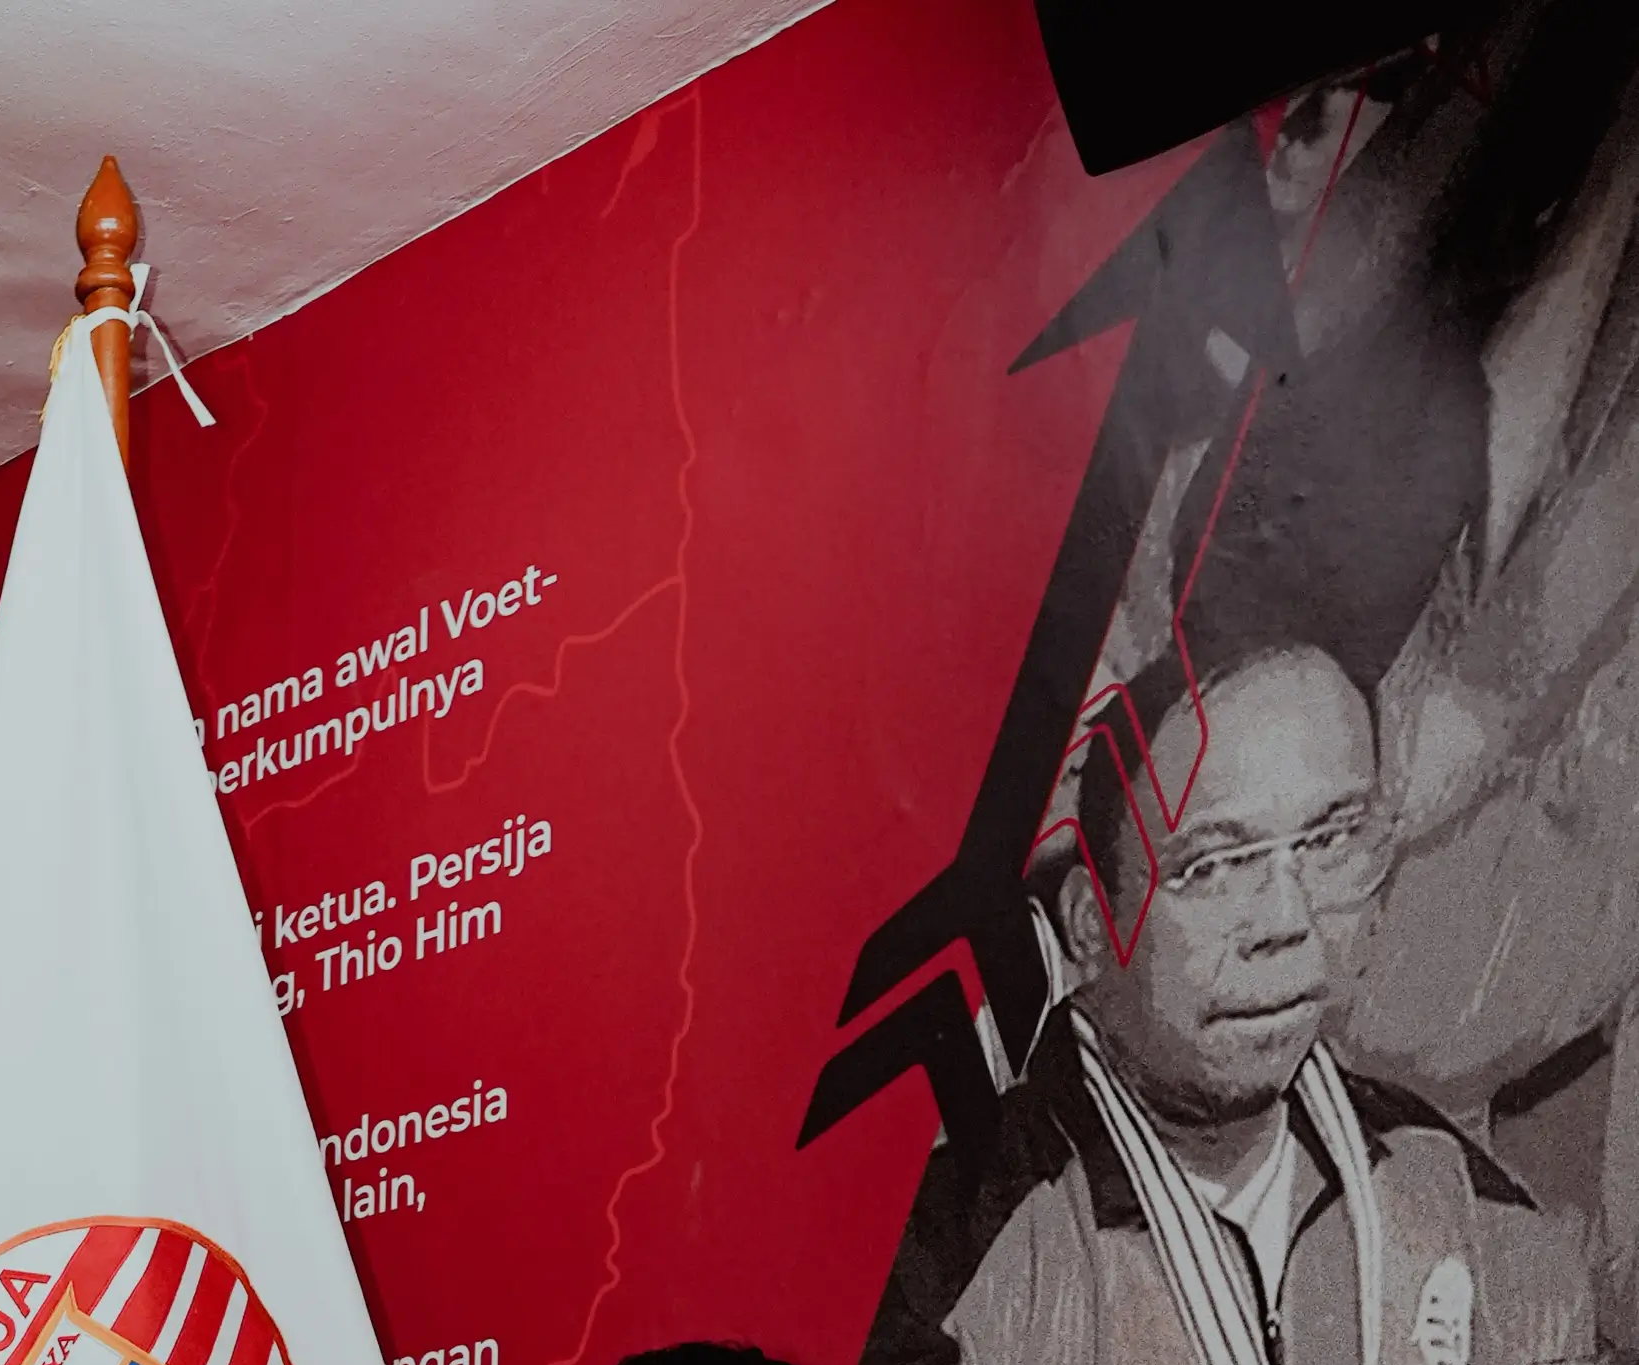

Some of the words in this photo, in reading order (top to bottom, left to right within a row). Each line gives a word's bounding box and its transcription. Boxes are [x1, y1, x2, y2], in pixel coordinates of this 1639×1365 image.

[216, 666, 324, 740] nama
[335, 607, 429, 687] awal
[441, 564, 558, 641] Voet-
[274, 878, 396, 949] ketua.
[409, 813, 553, 901] Persija
[315, 929, 403, 993] Thio
[415, 900, 502, 960] Him
[344, 1167, 426, 1222] lain,
